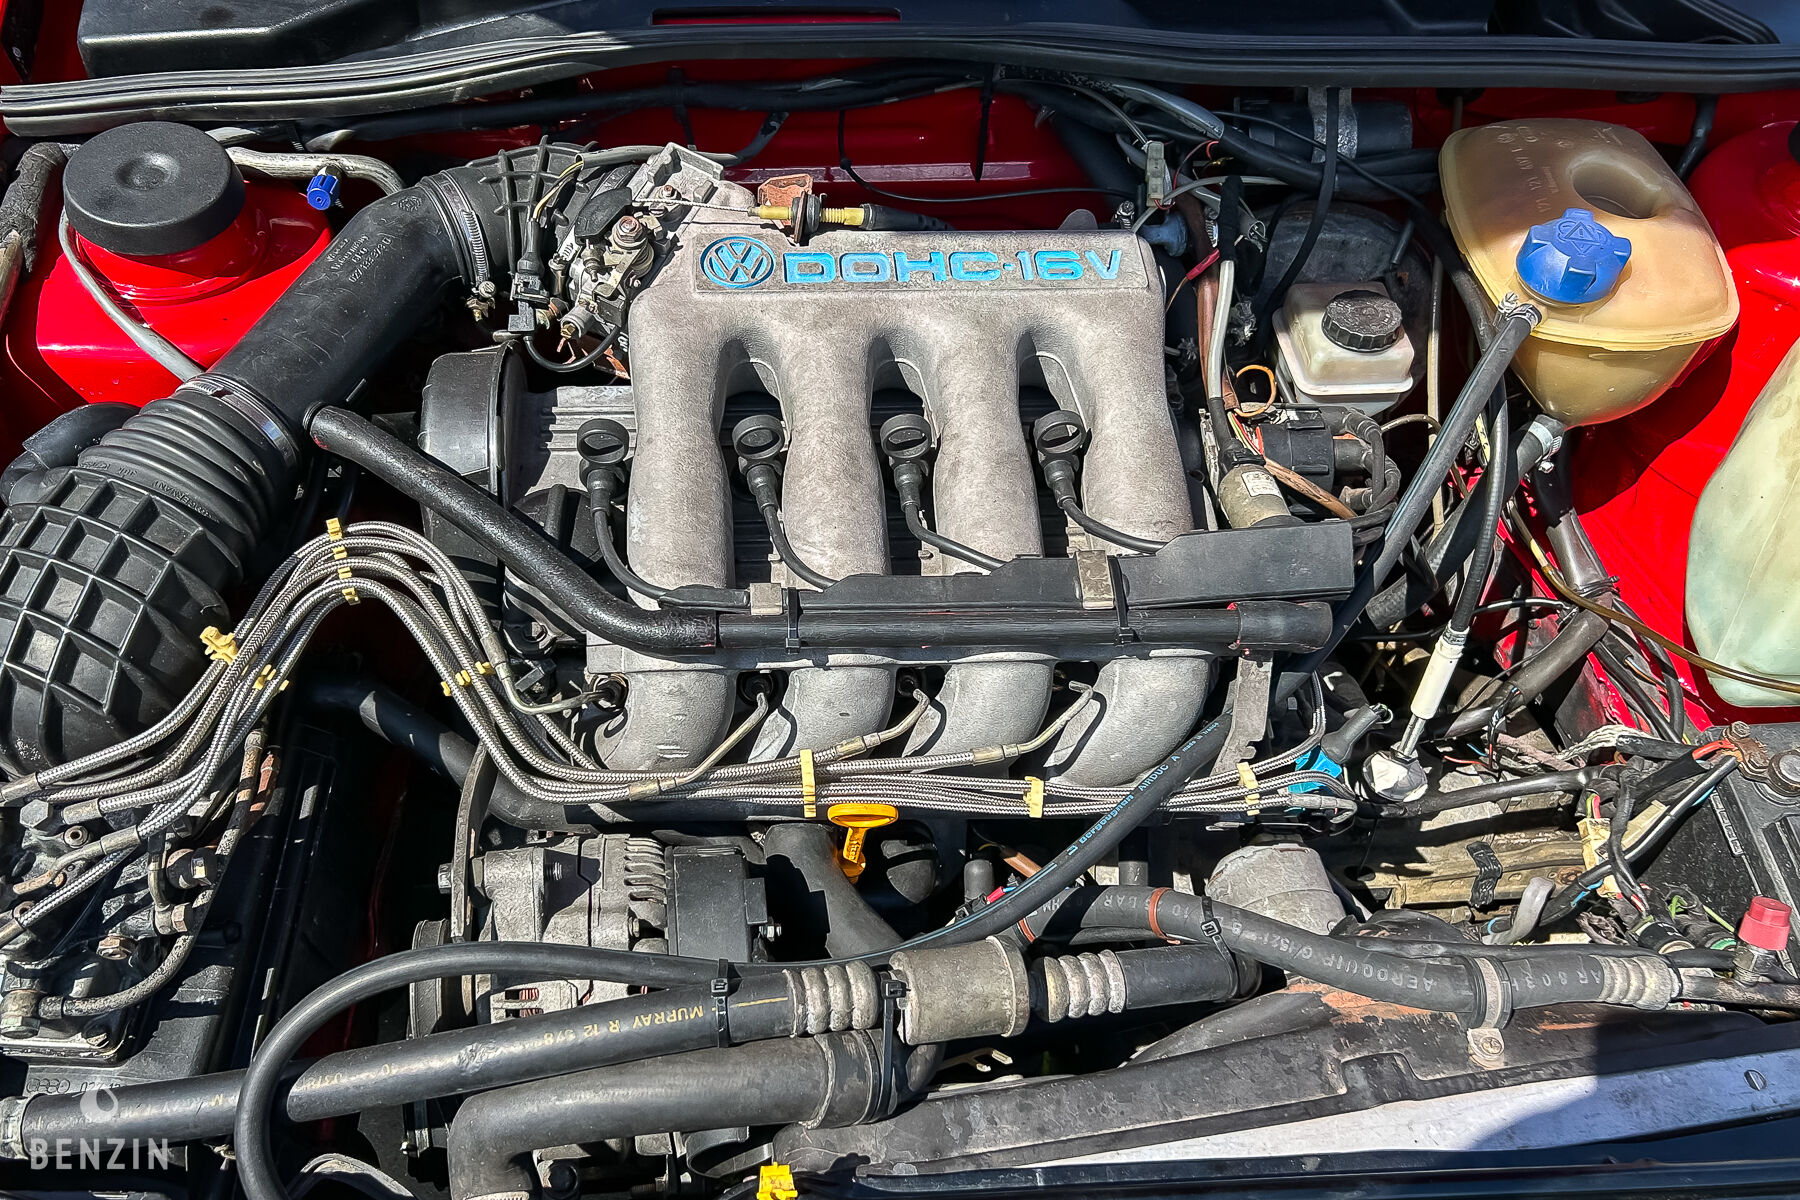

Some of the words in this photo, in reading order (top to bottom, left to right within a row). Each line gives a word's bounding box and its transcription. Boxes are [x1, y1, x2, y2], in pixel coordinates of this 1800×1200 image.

[1138, 764, 1169, 791] AIRDUC
[1170, 754, 1181, 762] A
[583, 1023, 600, 1037] 12
[608, 1019, 620, 1033] R
